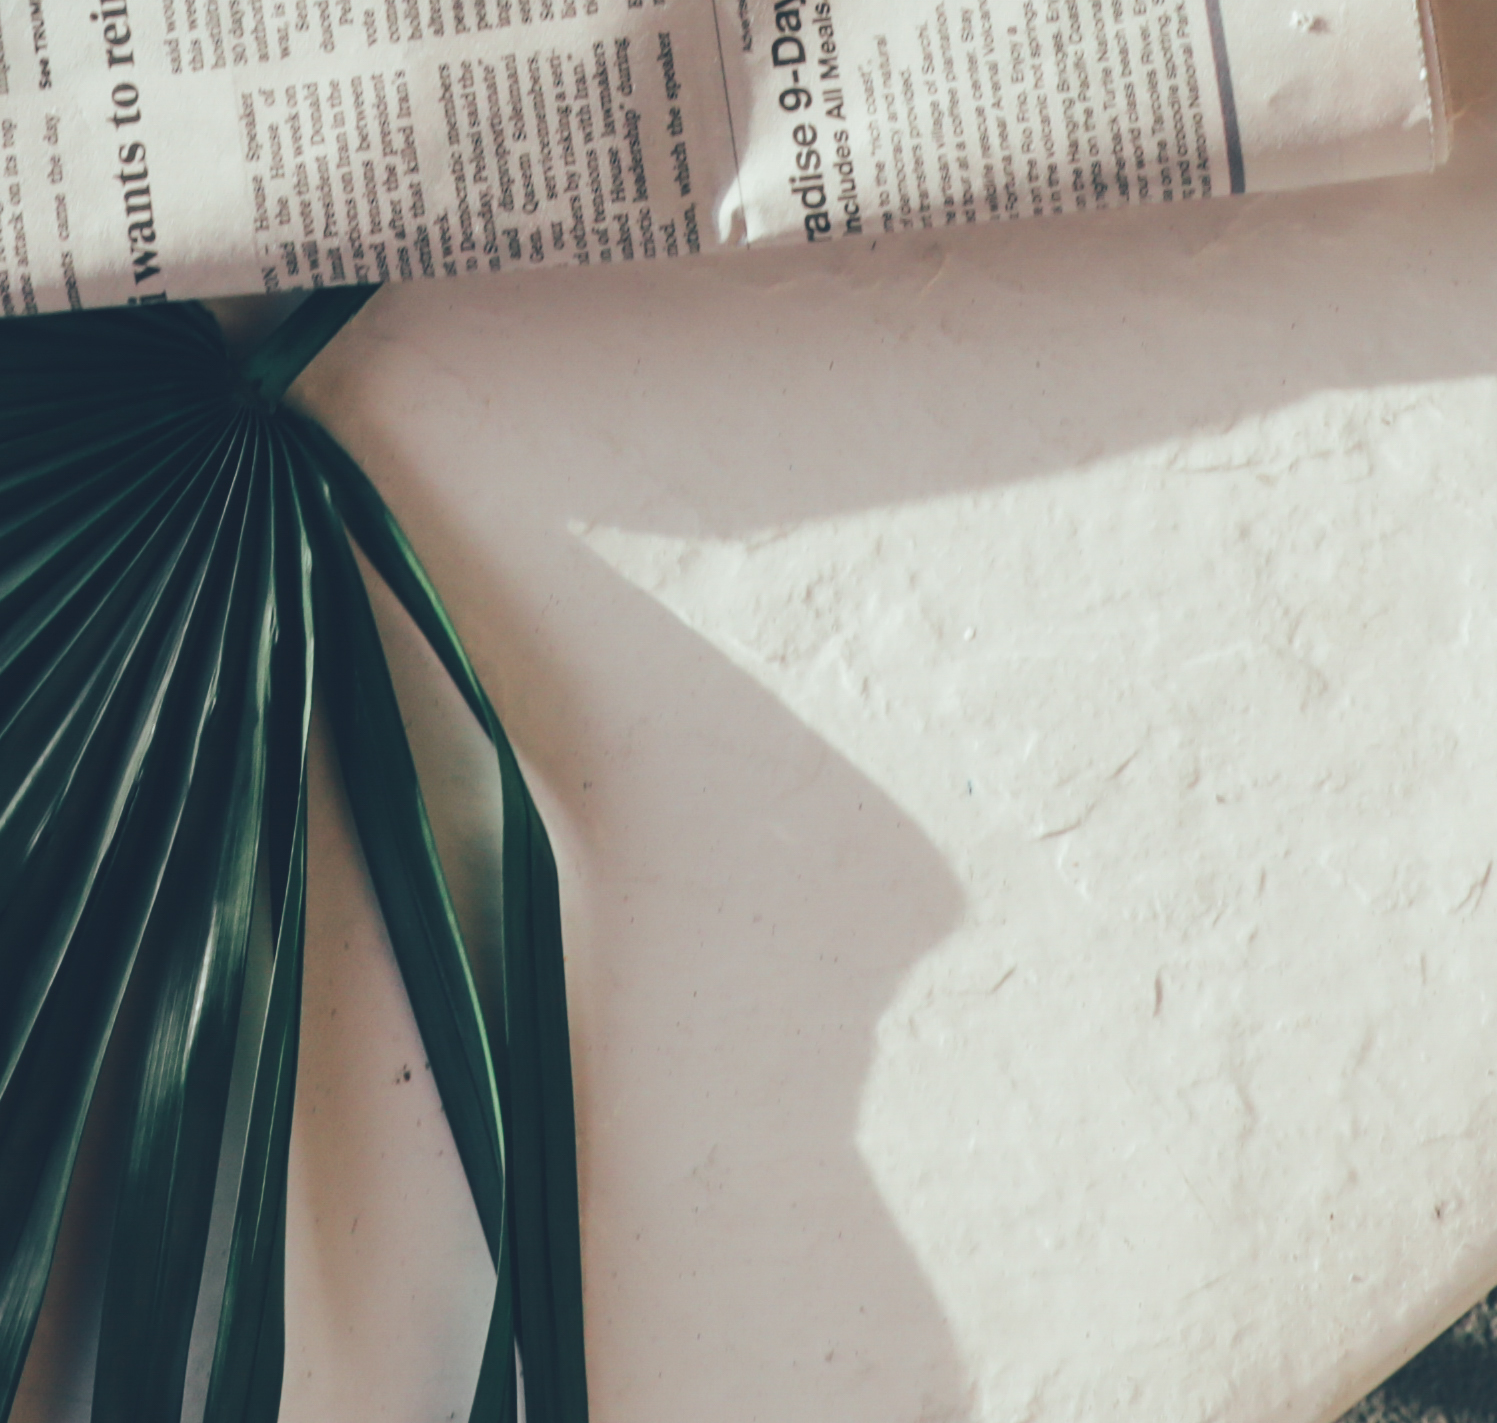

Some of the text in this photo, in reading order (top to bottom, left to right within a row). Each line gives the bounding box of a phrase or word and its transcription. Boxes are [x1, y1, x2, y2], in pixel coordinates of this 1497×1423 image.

[38, 57, 52, 90] See
[985, 60, 1003, 111] Arenal
[109, 82, 142, 129] to
[656, 31, 692, 197] which the speaker
[822, 88, 846, 121] All
[996, 116, 1011, 150] near
[116, 141, 160, 284] wants
